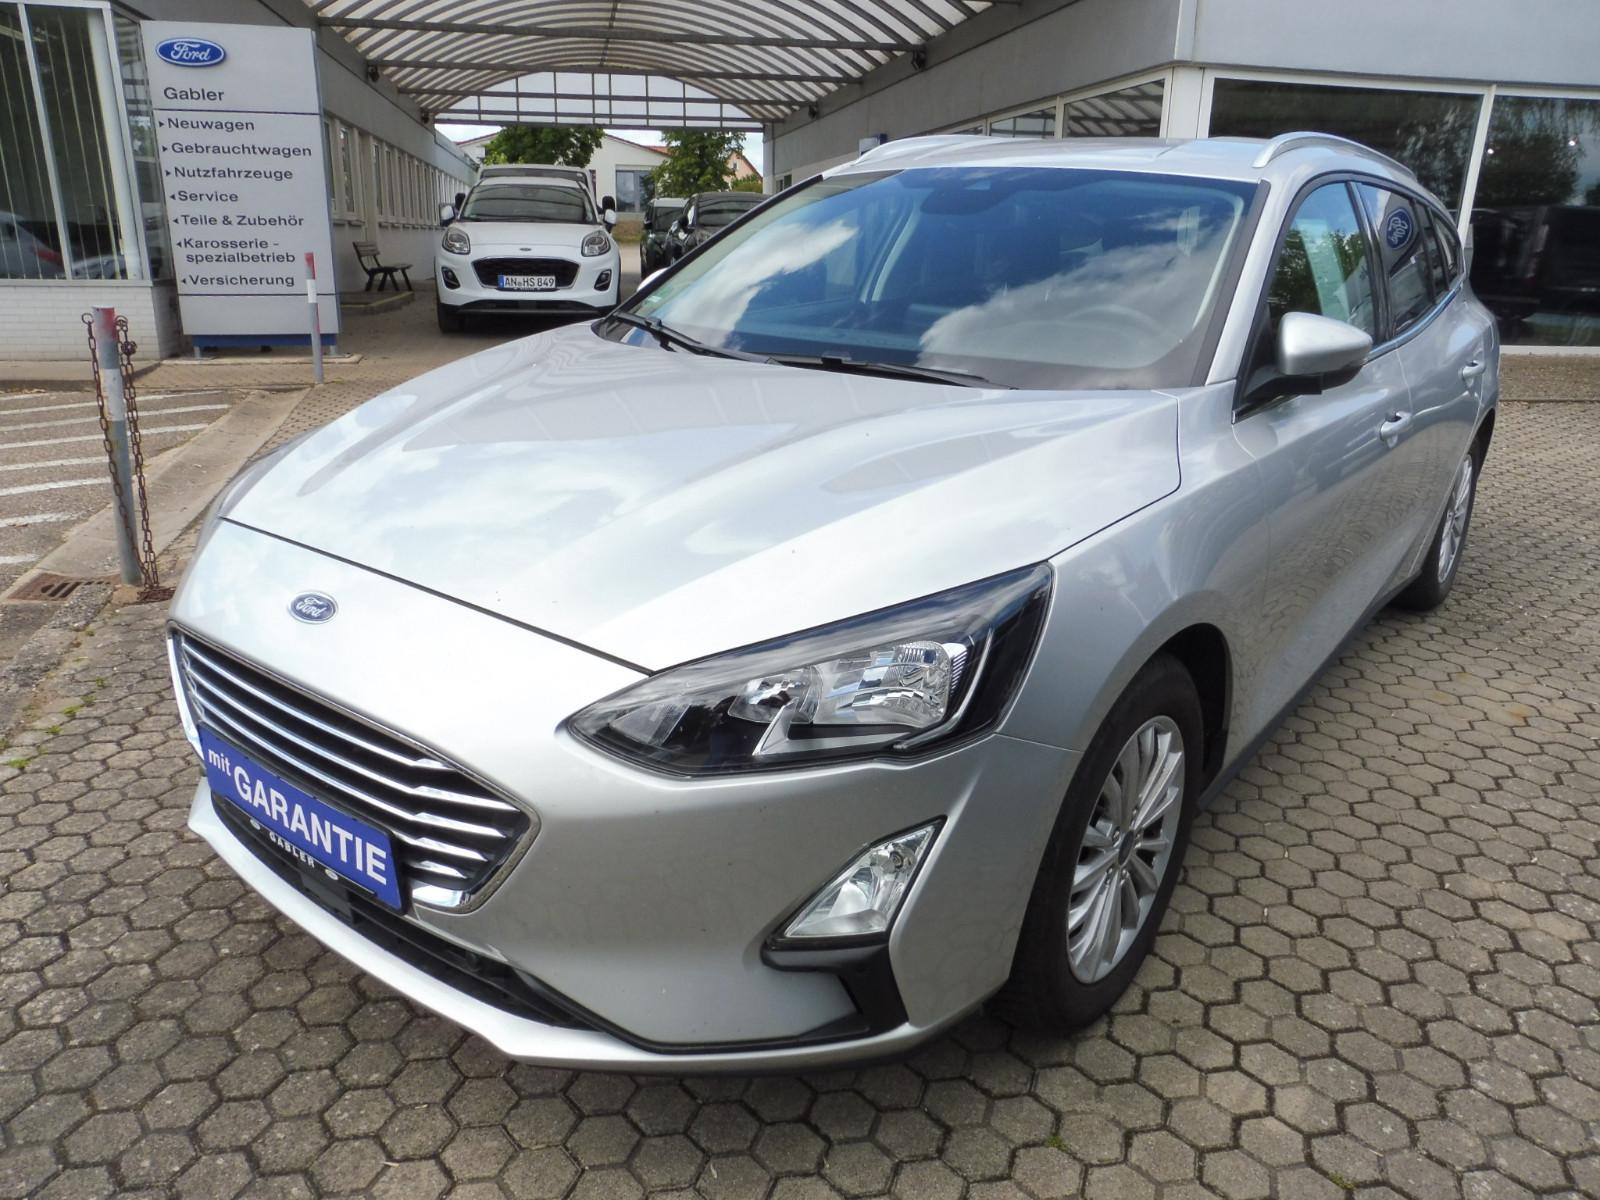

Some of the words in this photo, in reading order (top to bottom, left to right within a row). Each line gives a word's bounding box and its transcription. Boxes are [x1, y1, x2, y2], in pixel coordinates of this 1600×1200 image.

[170, 41, 212, 61] Ford
[163, 86, 225, 102] Gabler
[167, 117, 255, 133] Neuwagen
[171, 142, 312, 159] Gebrauchtwagen
[174, 167, 293, 182] Nutzfahrzeuge
[178, 190, 239, 202] Service
[181, 214, 218, 226] Teile
[222, 215, 233, 226] &
[236, 215, 304, 227] Zubehör
[186, 251, 296, 265] spezialbetrieb
[189, 274, 295, 288] Versicherung
[537, 277, 554, 287] 849
[296, 596, 328, 618] Ford
[208, 748, 232, 777] mit
[233, 765, 387, 886] GARANTIE
[269, 830, 315, 869] GABLER
